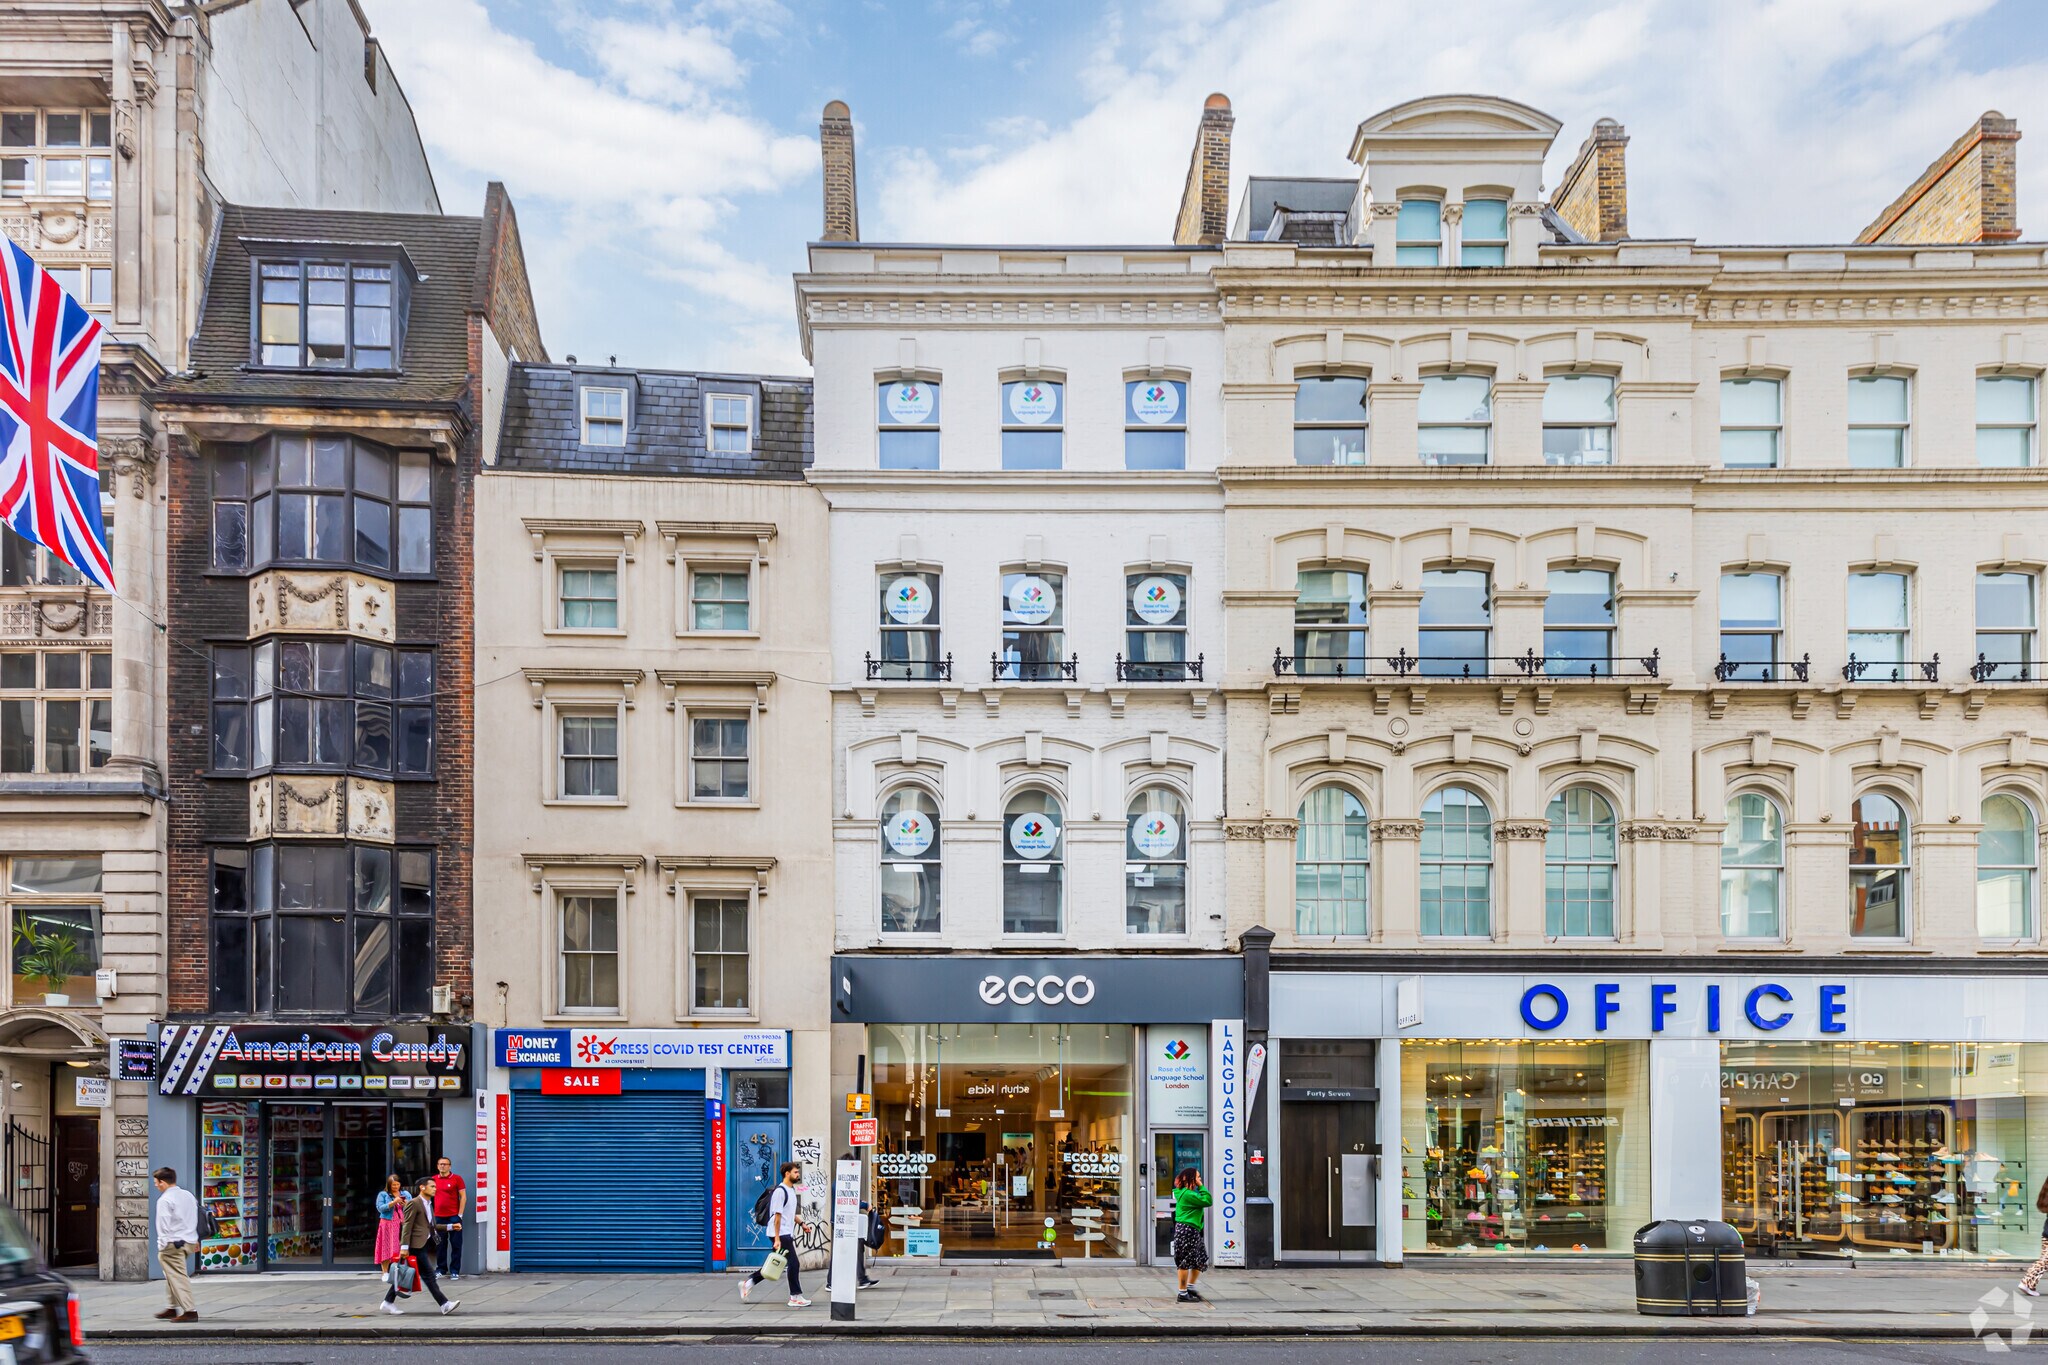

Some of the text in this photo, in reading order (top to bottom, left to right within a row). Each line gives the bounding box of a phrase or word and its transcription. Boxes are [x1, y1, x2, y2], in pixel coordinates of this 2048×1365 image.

[979, 975, 1095, 1005] ecco
[1520, 984, 1846, 1032] OFFICE
[508, 1035, 558, 1049] MONEY
[122, 1048, 153, 1059] American
[219, 1031, 462, 1070] American Candy
[653, 1044, 694, 1054] COVID
[698, 1044, 724, 1054] TEST
[728, 1044, 774, 1054] CENTRE
[507, 1049, 560, 1063] EXCHANGE
[128, 1060, 148, 1073] Candy
[564, 1076, 599, 1086] SALE
[716, 1130, 721, 1138] TO
[1222, 1025, 1236, 1233] LANGUAGE SCHOOL
[501, 1138, 506, 1147] TO
[501, 1151, 506, 1161] UP
[872, 1154, 936, 1163] ECCO 2ND
[1064, 1153, 1128, 1163] ECCO 2ND
[880, 1164, 928, 1173] COZMO
[1072, 1163, 1120, 1173] COZMO
[716, 1194, 721, 1203] UP
[716, 1208, 721, 1216] TO
[502, 1217, 506, 1226] TO
[502, 1230, 506, 1239] UP
